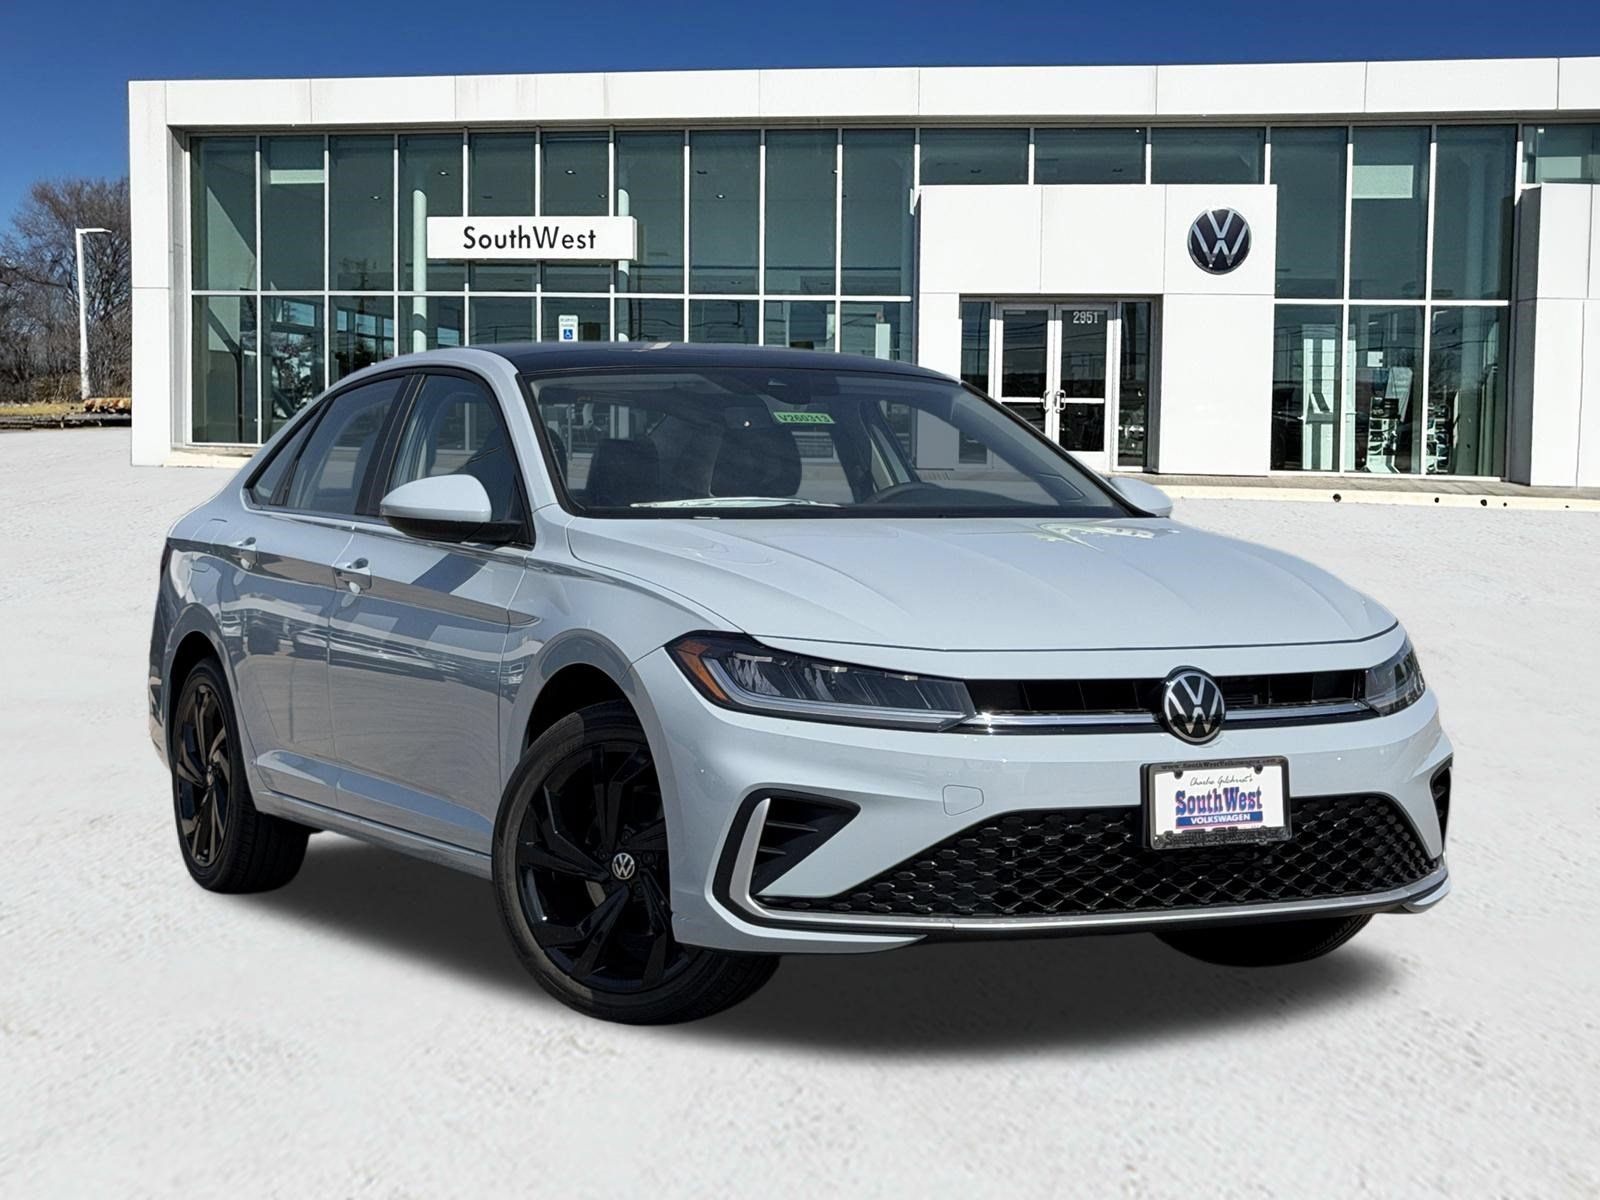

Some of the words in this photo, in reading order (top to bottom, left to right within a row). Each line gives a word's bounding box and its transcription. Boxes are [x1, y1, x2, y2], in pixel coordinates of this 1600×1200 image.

[463, 225, 597, 250] SouthWest
[1072, 311, 1099, 324] 2951
[1175, 786, 1263, 816] SouthWest
[1189, 813, 1252, 825] VOLKSWAGEN
